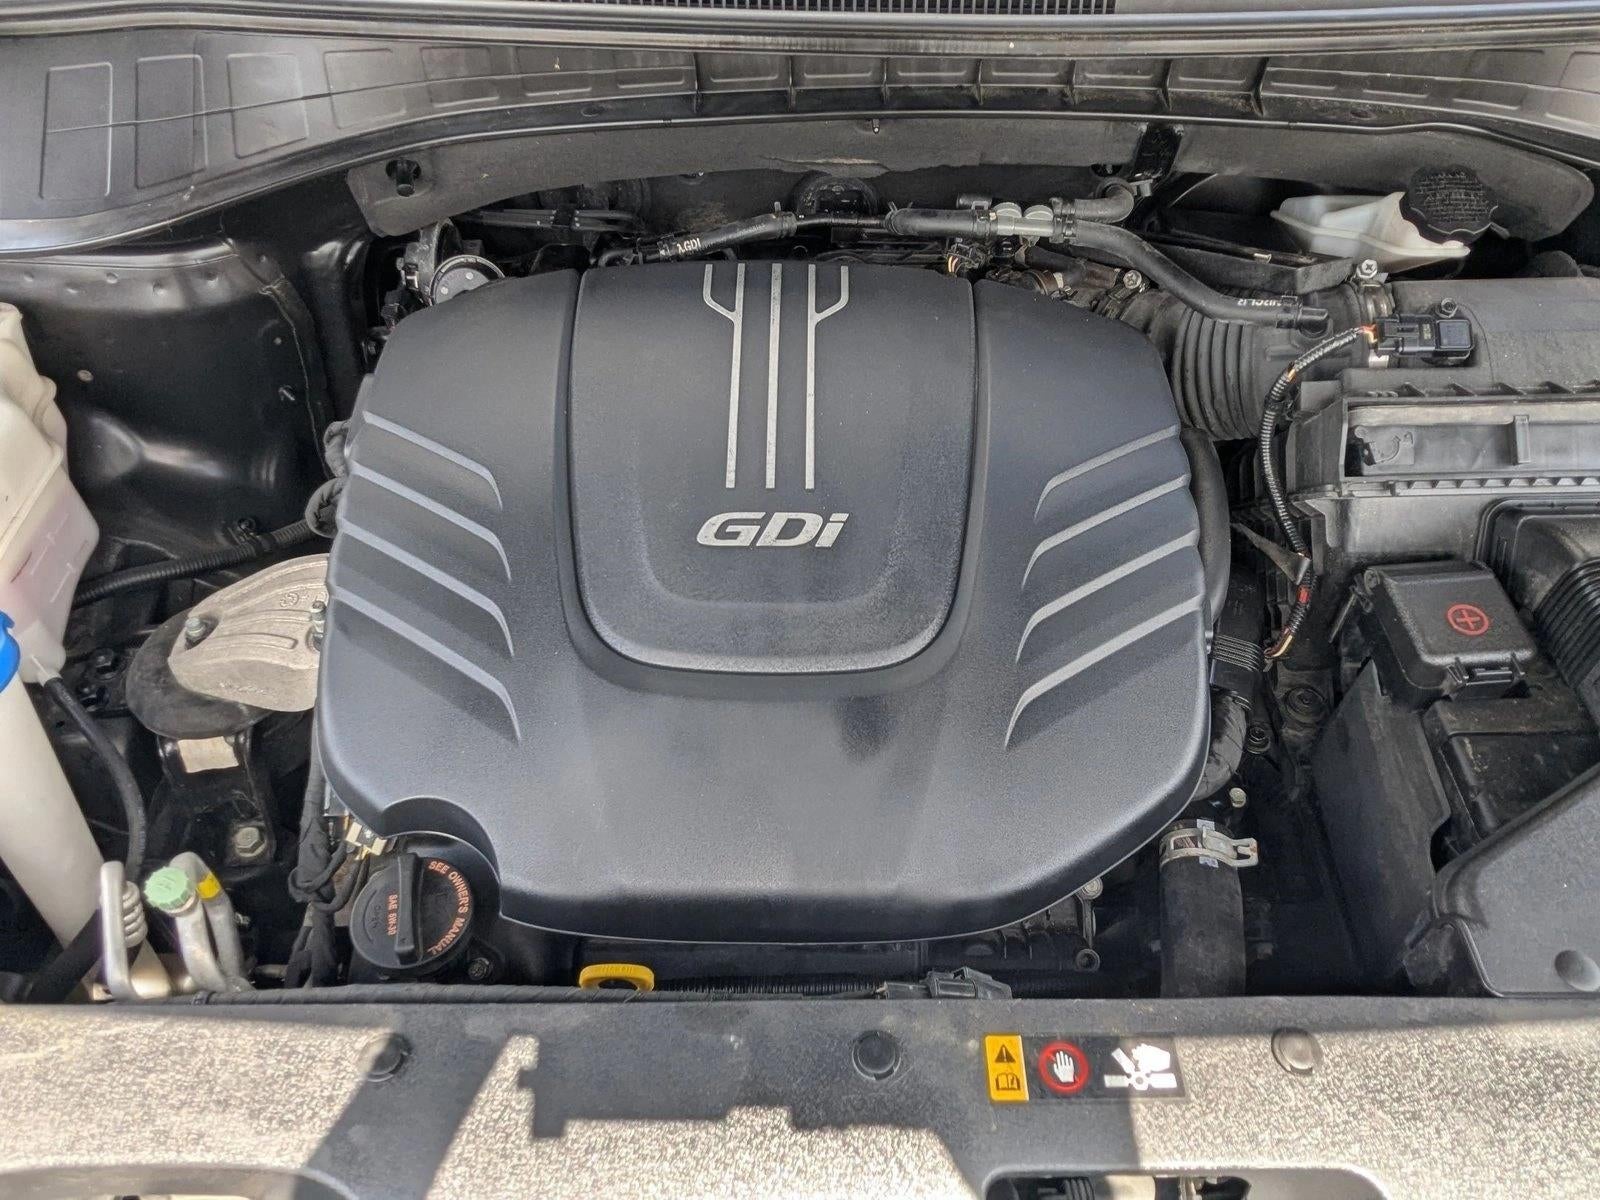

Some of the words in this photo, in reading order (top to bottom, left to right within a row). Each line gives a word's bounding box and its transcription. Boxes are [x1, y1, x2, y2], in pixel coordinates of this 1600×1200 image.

[696, 511, 849, 547] GDi
[428, 860, 451, 874] SEE
[388, 894, 398, 910] SAE
[448, 871, 470, 914] OWNER'S
[427, 917, 465, 955] MANUAL
